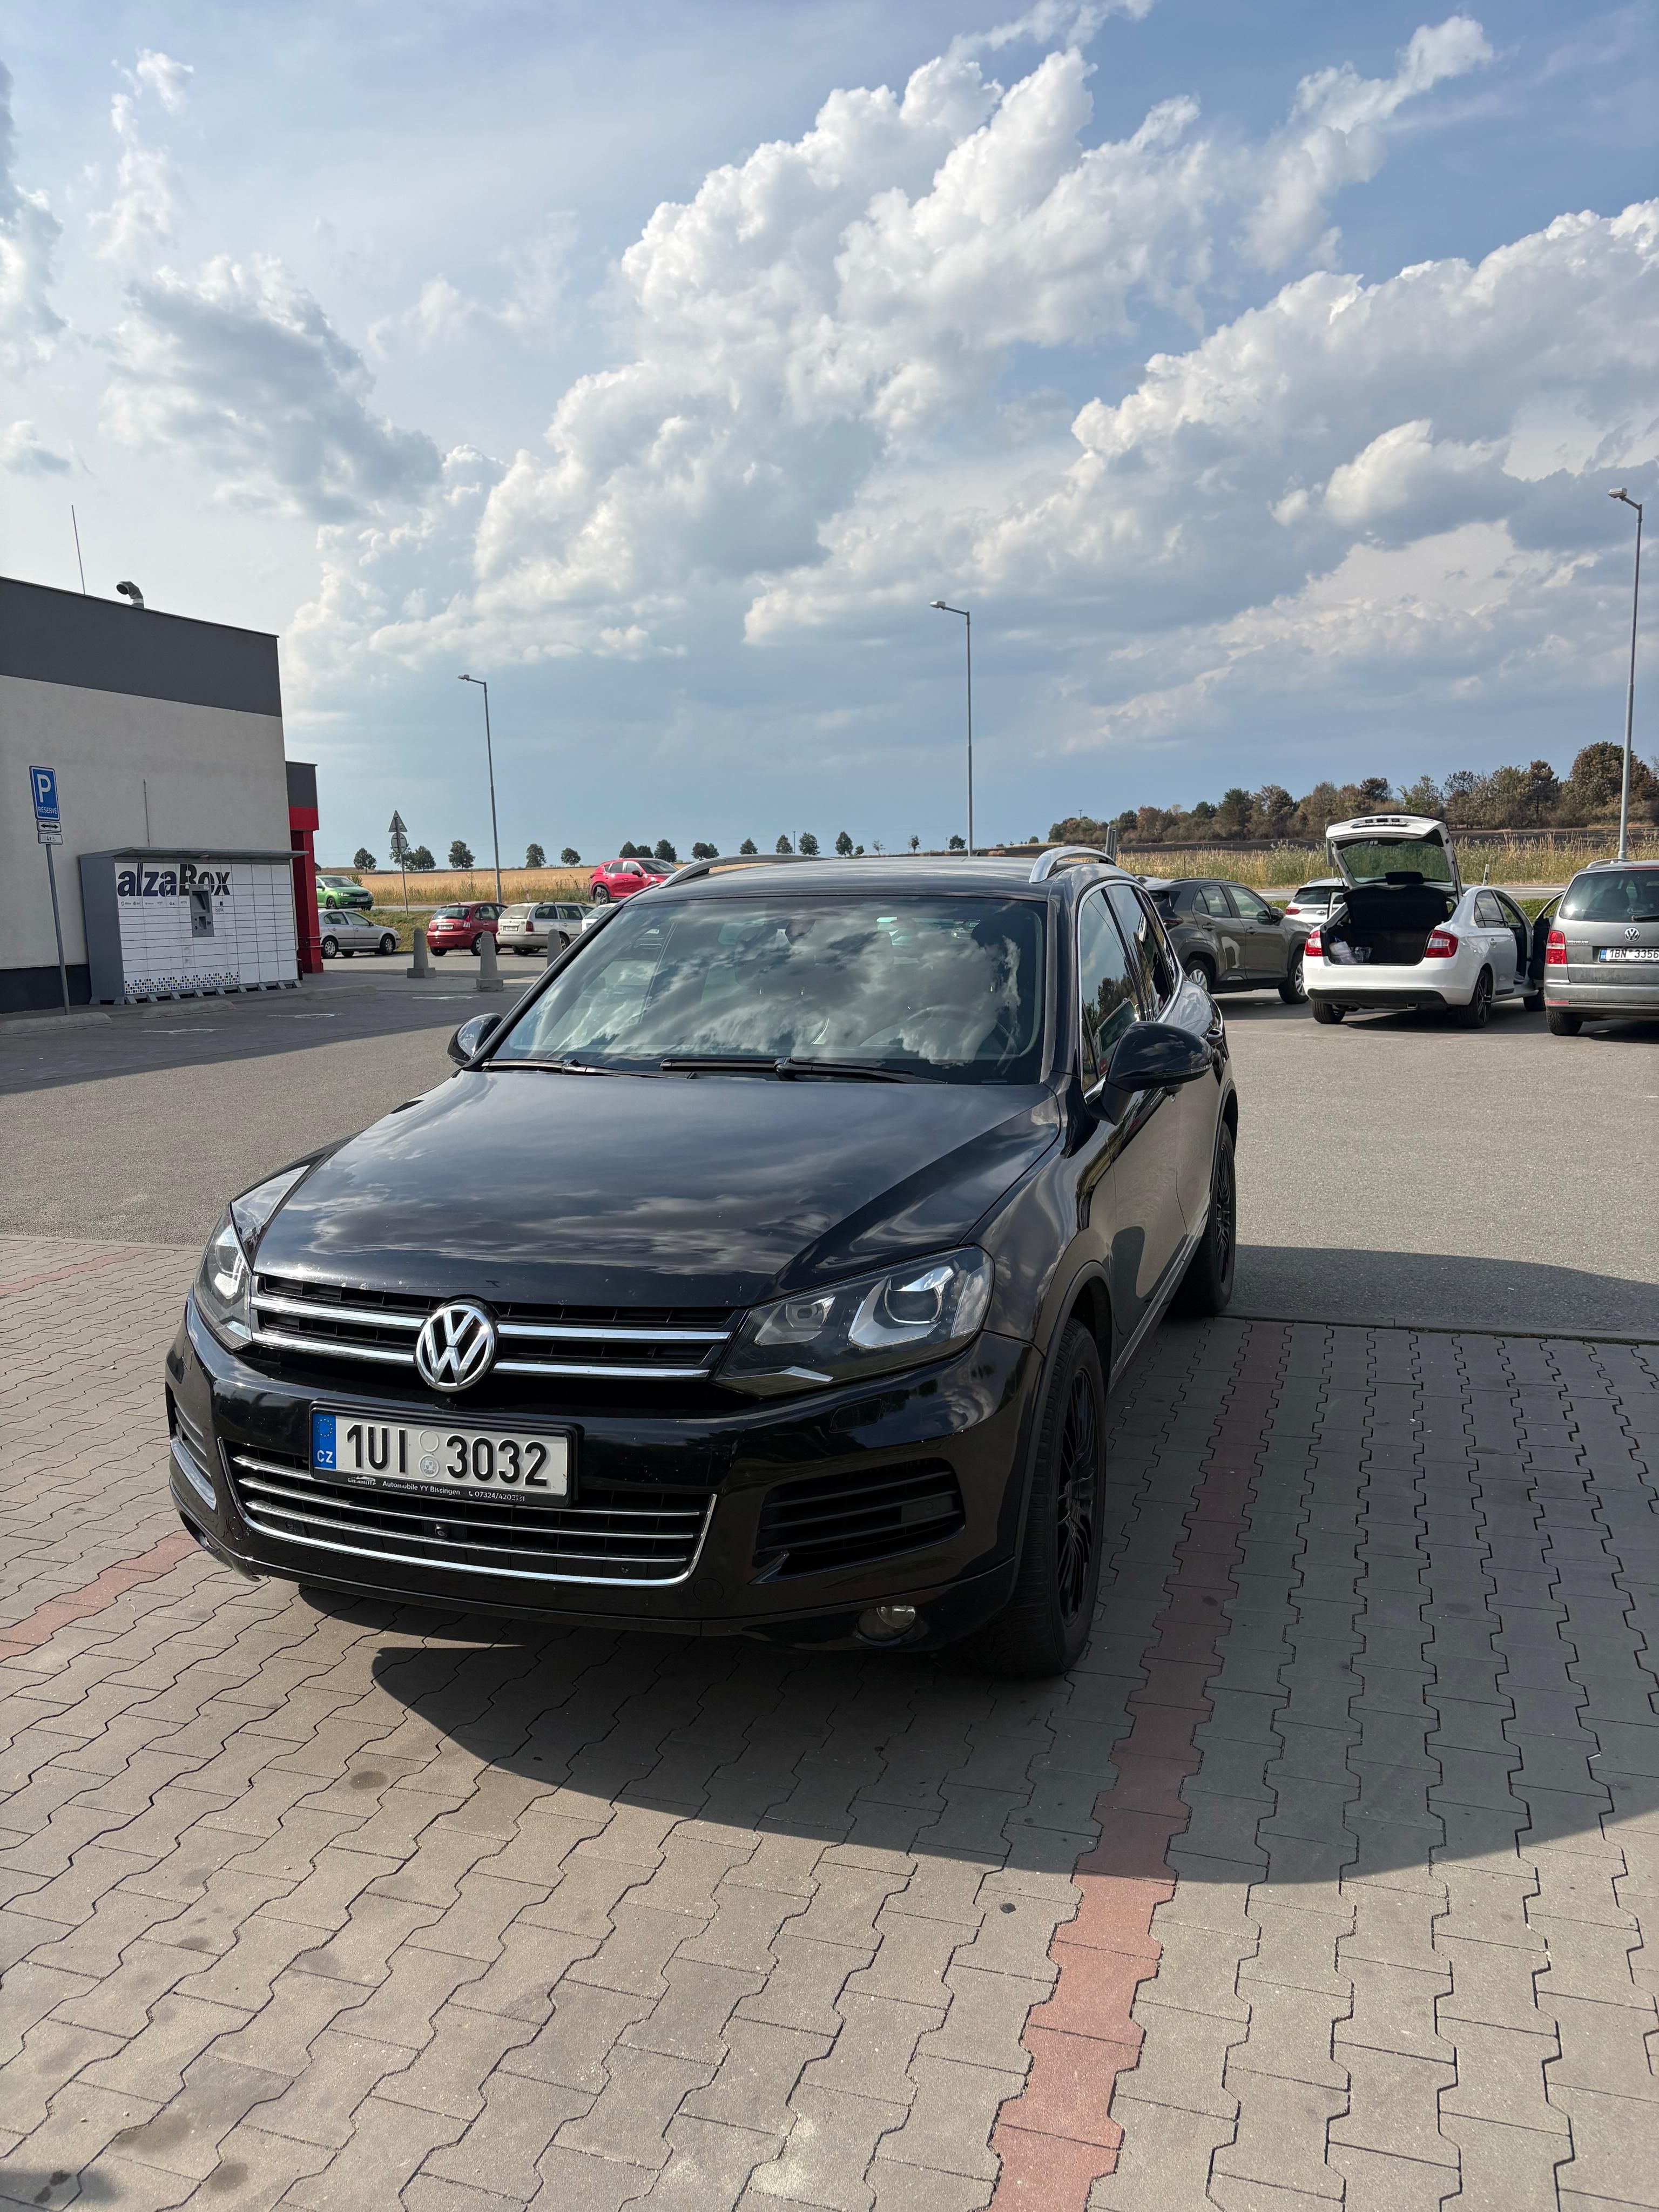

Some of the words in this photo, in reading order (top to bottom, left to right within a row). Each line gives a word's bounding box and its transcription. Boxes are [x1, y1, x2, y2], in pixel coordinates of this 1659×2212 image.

[37, 773, 51, 803] P
[1609, 949, 1627, 958] 1BN
[1634, 949, 1659, 959] 3356
[316, 1449, 333, 1464] CZ
[346, 1424, 406, 1474] 1UI
[446, 1433, 548, 1487] 3032
[382, 1481, 419, 1491] Automobile
[430, 1486, 461, 1495] Bissingen
